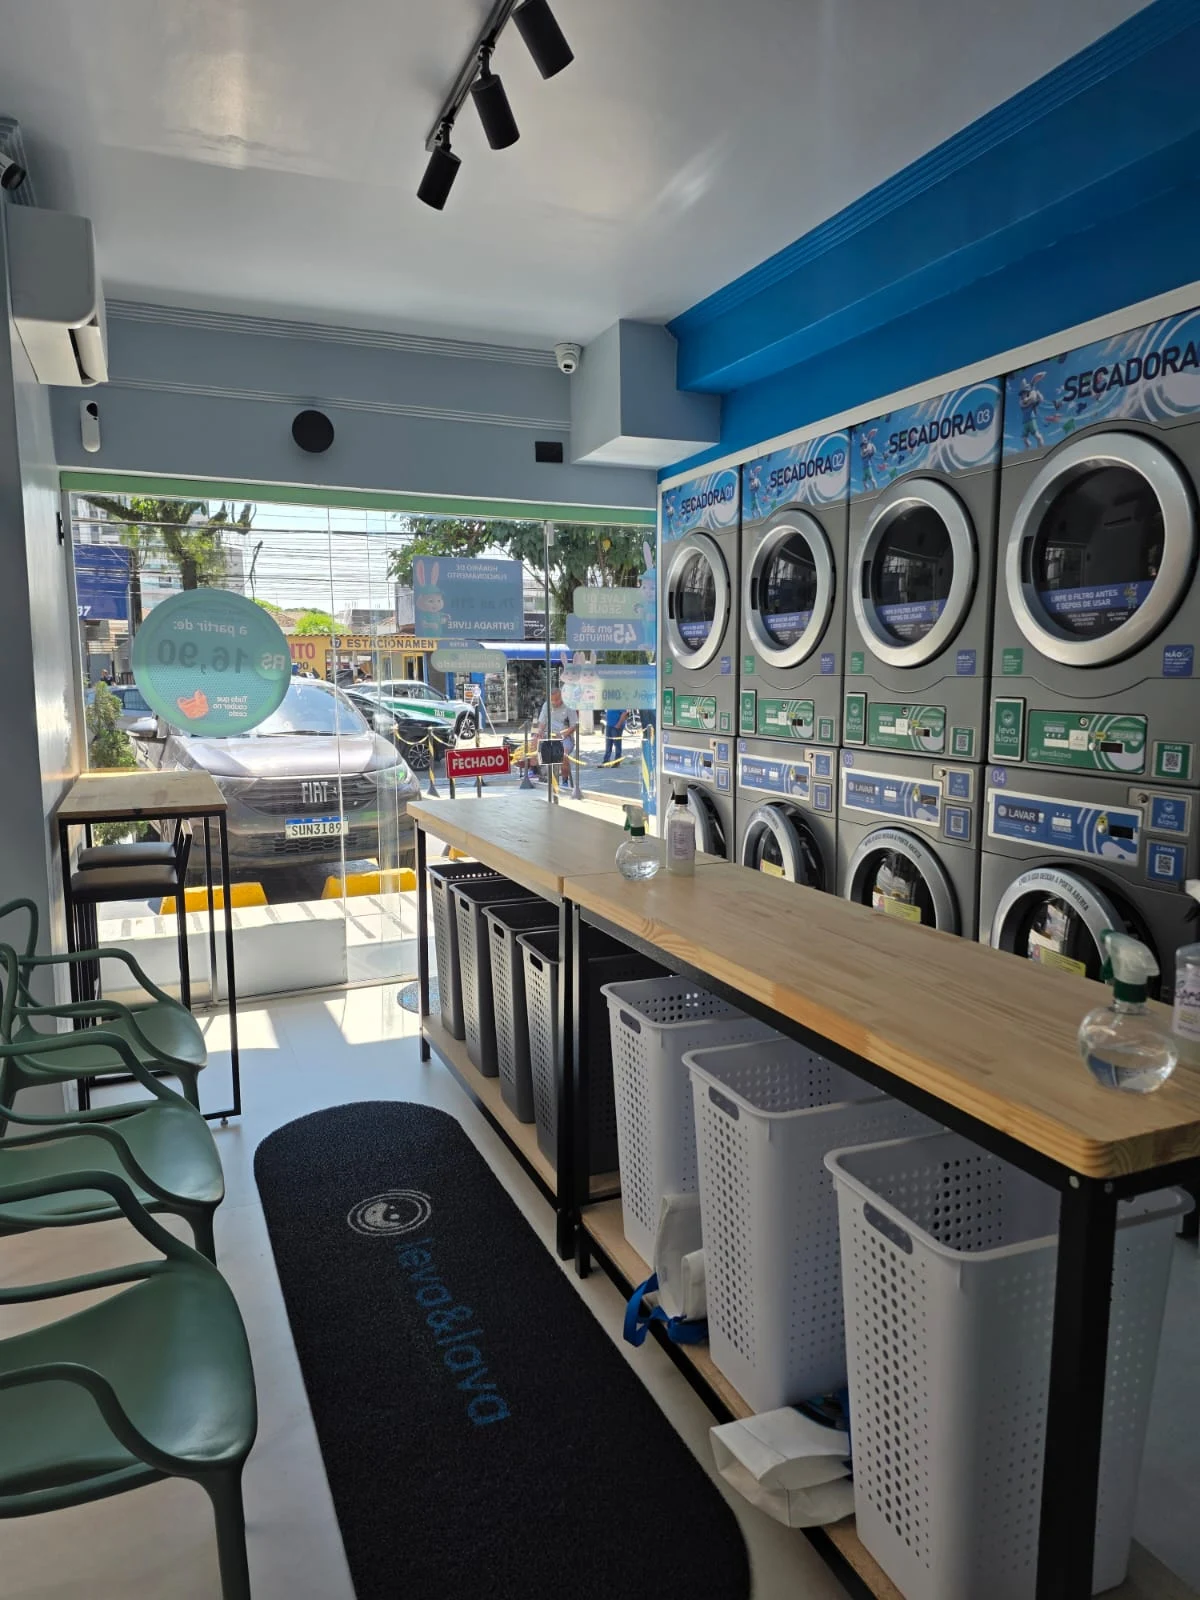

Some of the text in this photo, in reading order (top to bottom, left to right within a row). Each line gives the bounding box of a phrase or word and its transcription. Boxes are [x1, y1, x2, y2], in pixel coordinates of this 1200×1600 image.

[1063, 341, 1200, 402] SECADORA
[888, 408, 990, 454] SECADORA 03
[770, 452, 844, 488] SECADORA 02
[680, 485, 733, 514] SECADORA 01
[1072, 592, 1094, 600] FILTRO
[1096, 589, 1118, 598] ANTES
[452, 755, 504, 770] FECHADO
[993, 769, 1005, 784] 04
[302, 781, 328, 803] FIAT
[1008, 809, 1036, 821] LAVAR
[395, 1237, 512, 1426] leva&lava
